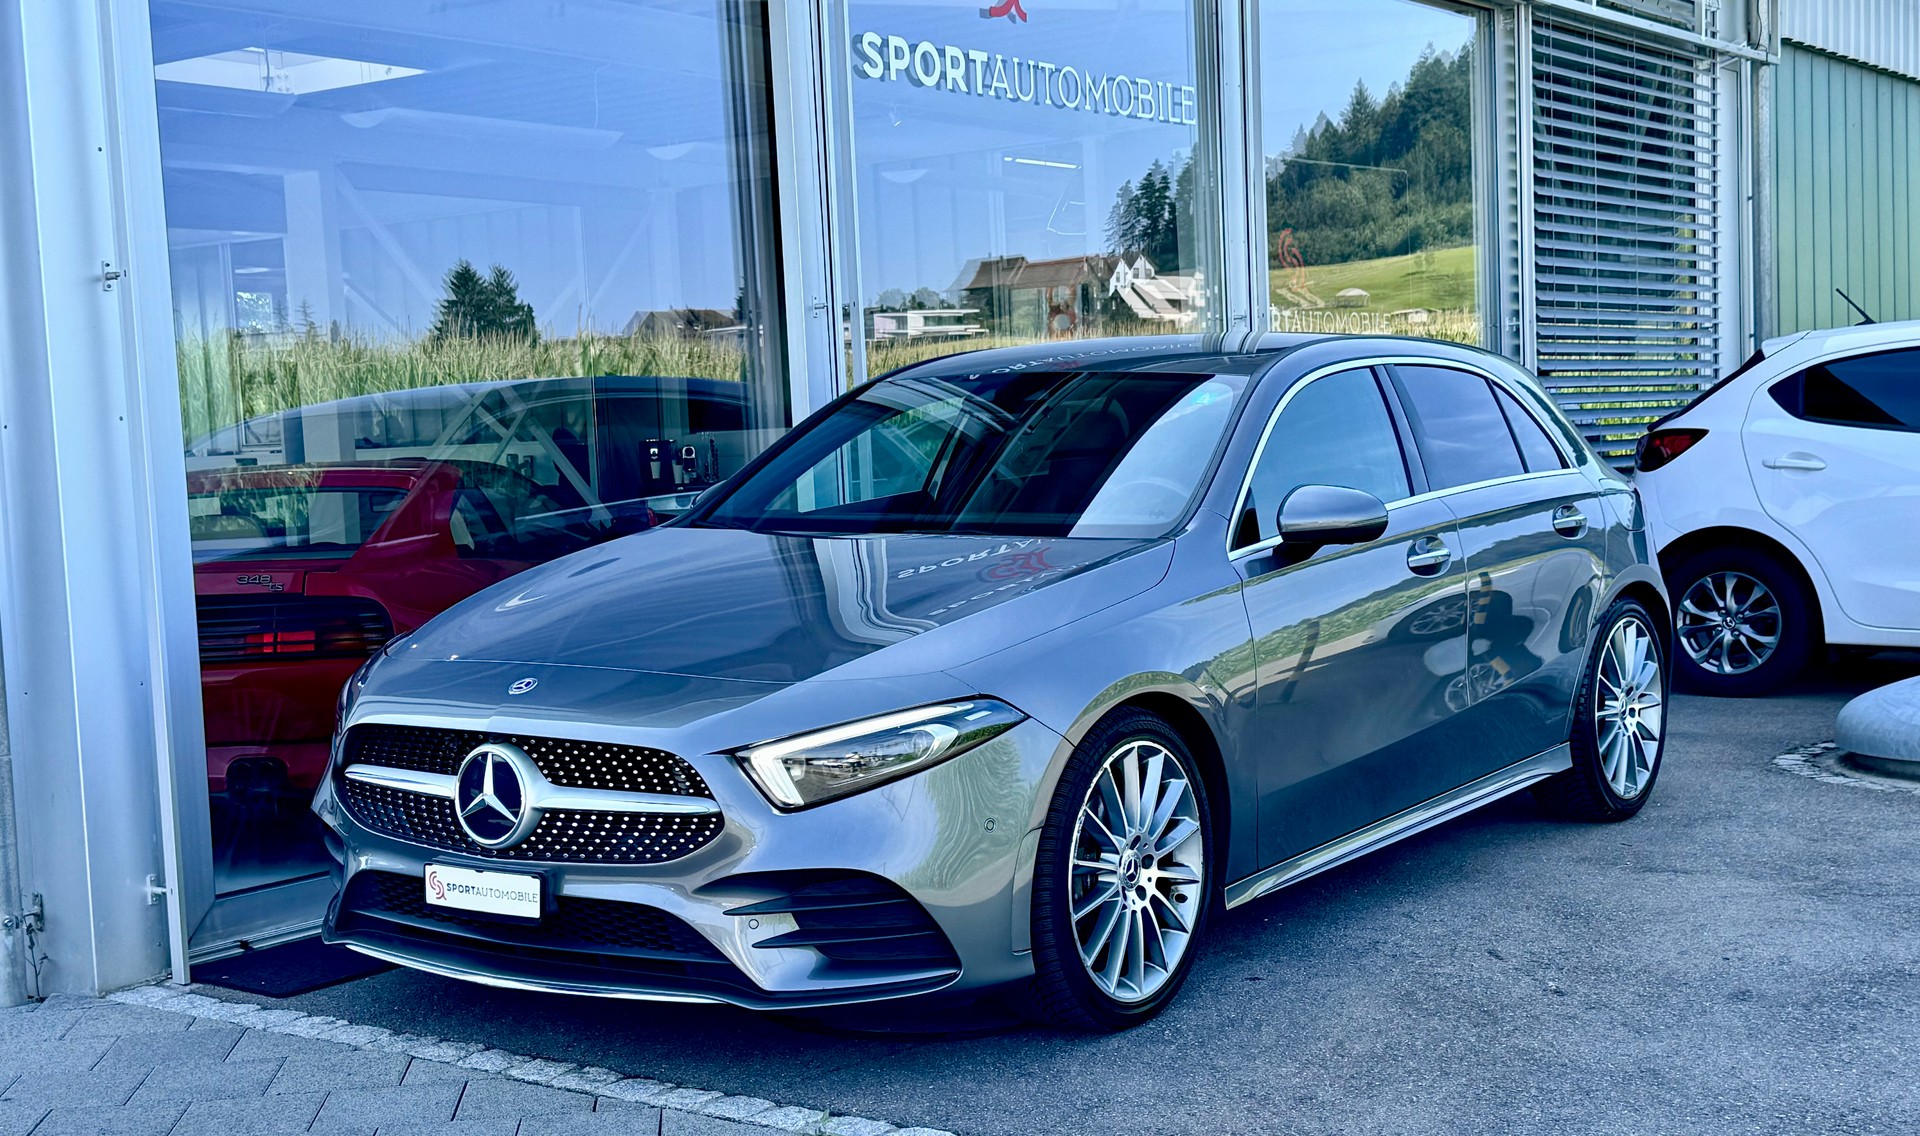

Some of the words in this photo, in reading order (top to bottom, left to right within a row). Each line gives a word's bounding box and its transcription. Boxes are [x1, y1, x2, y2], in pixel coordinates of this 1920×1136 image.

[862, 31, 1196, 125] SPORTAUTOMOBILE
[237, 574, 271, 584] 348
[446, 882, 538, 903] SPORTAUTOMOBILE
